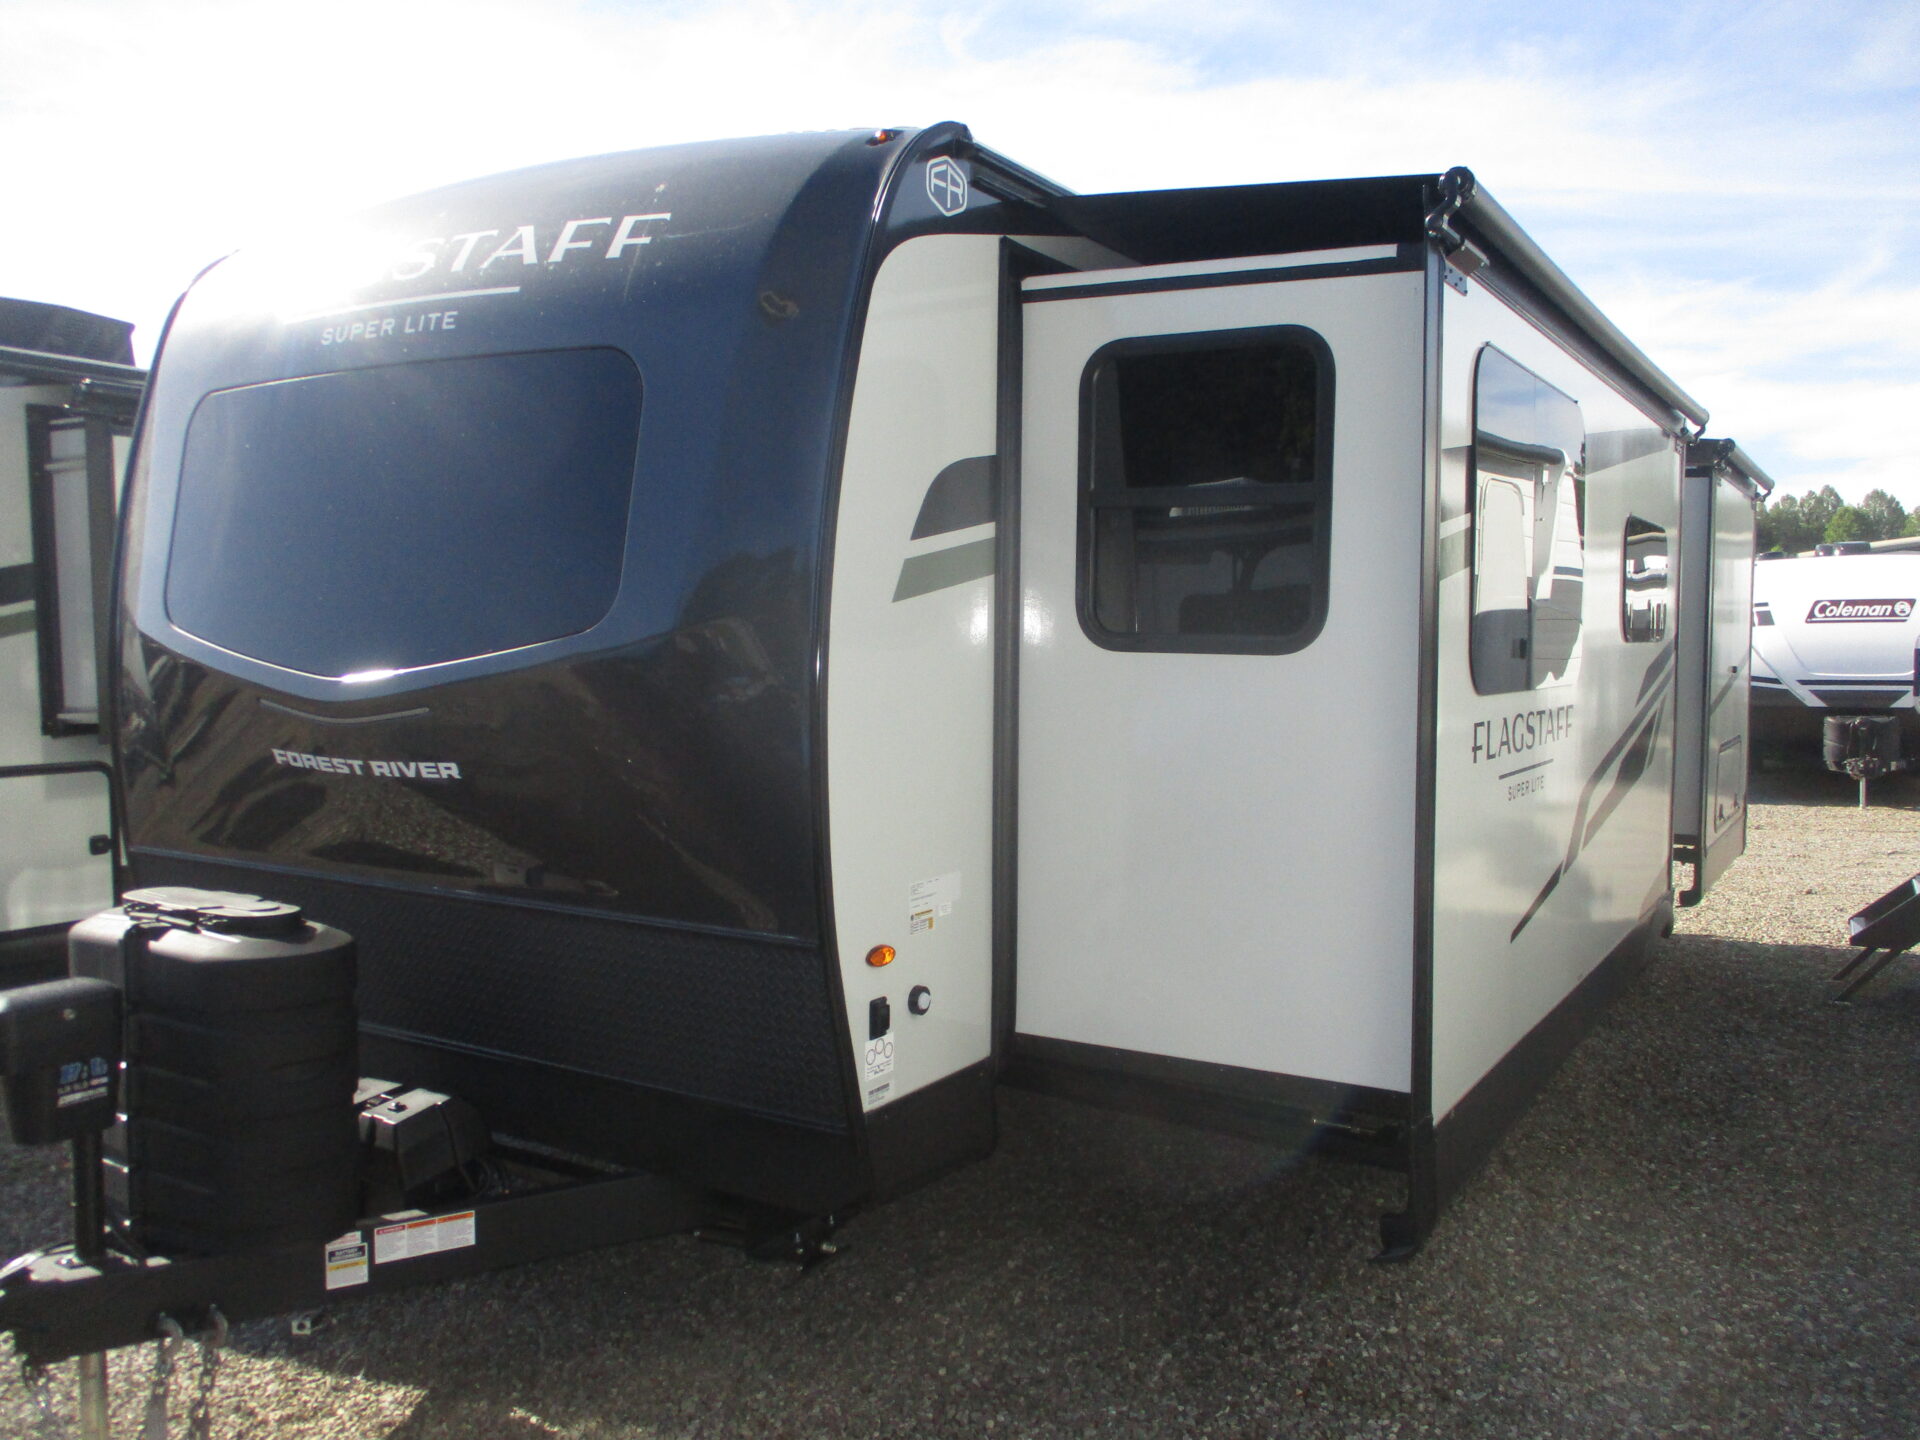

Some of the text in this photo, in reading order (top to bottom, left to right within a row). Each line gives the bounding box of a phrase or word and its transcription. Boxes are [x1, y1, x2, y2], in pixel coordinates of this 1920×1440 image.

[392, 212, 671, 281] STAFF
[321, 311, 458, 345] SUPER LITE
[1814, 601, 1892, 617] Coleman
[1472, 704, 1574, 763] FLAGSTAFF
[272, 749, 462, 779] FOREST RIVER
